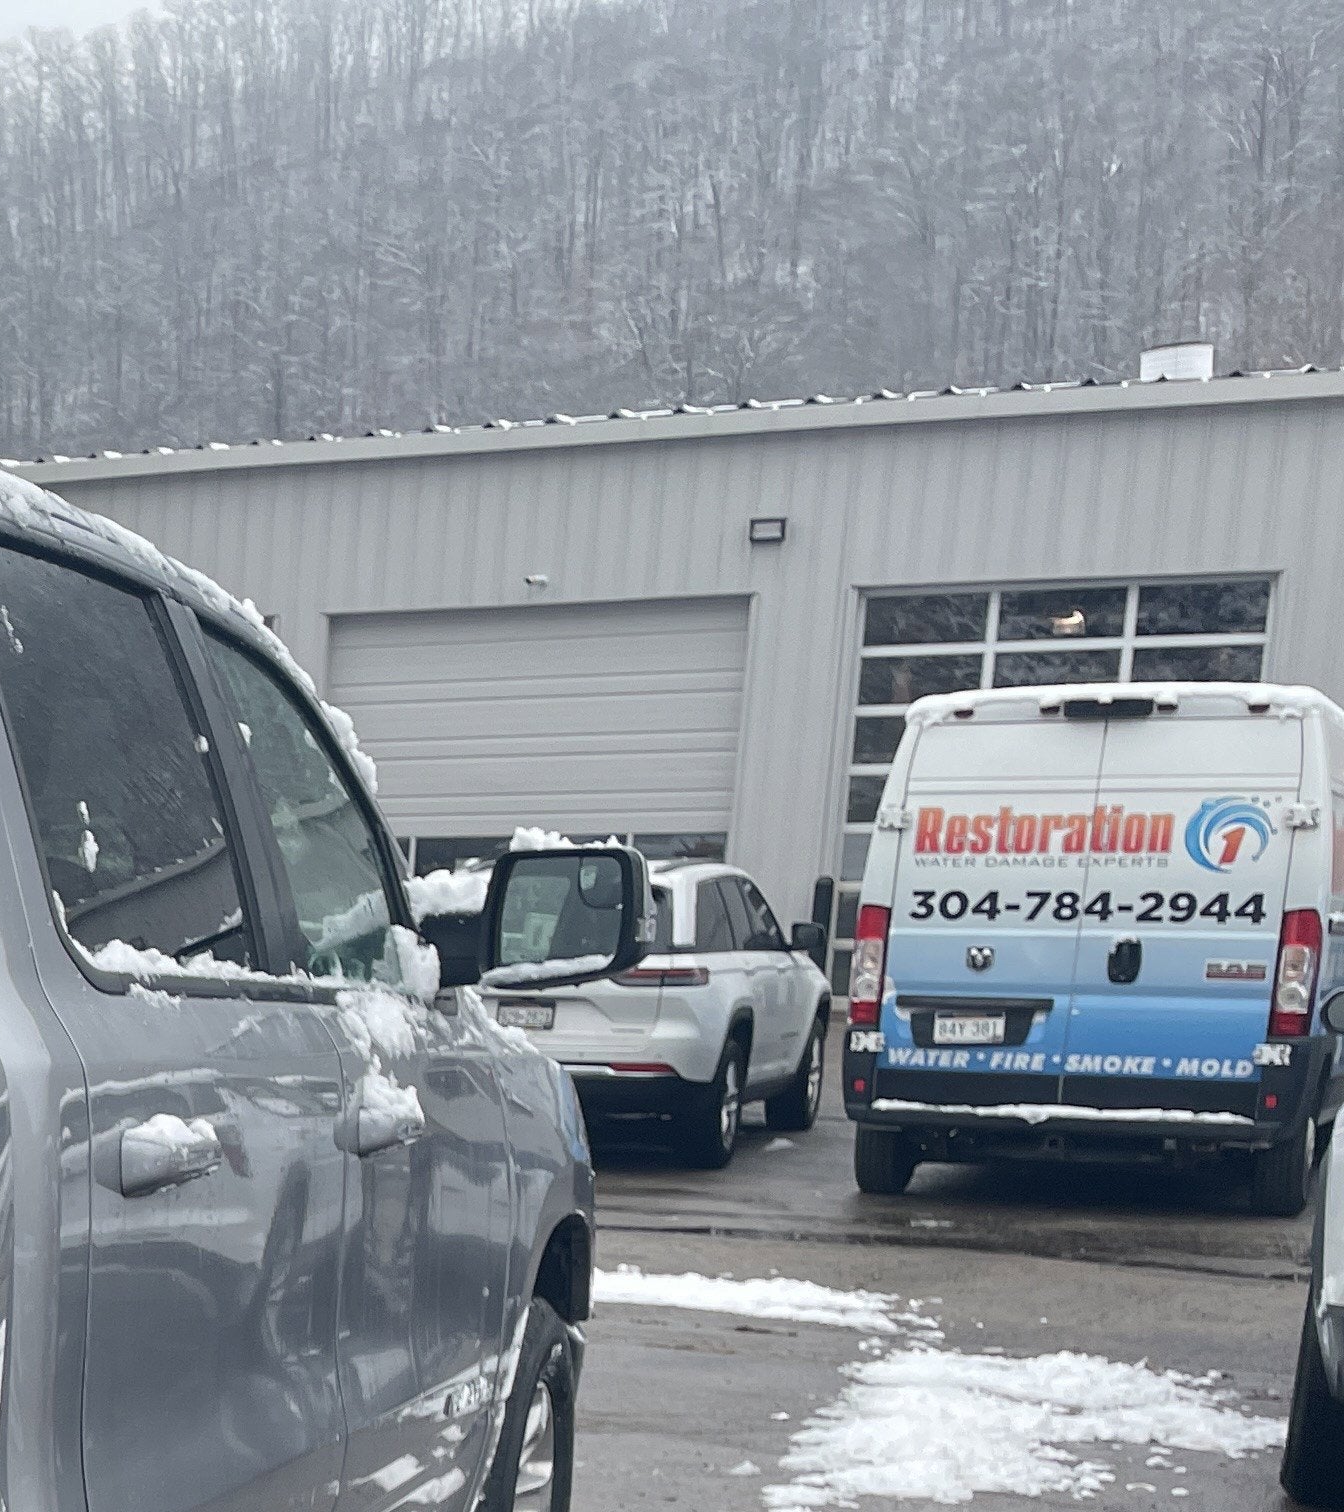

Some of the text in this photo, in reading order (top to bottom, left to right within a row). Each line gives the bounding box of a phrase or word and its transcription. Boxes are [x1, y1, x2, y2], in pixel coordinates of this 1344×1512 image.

[914, 804, 1246, 865] Restoration 1
[914, 856, 1169, 869] WATER DAMAGE EXPERTS
[909, 889, 1267, 925] 304-784-2944
[888, 1048, 1255, 1078] WATER FIRE SMOKE MOLD
